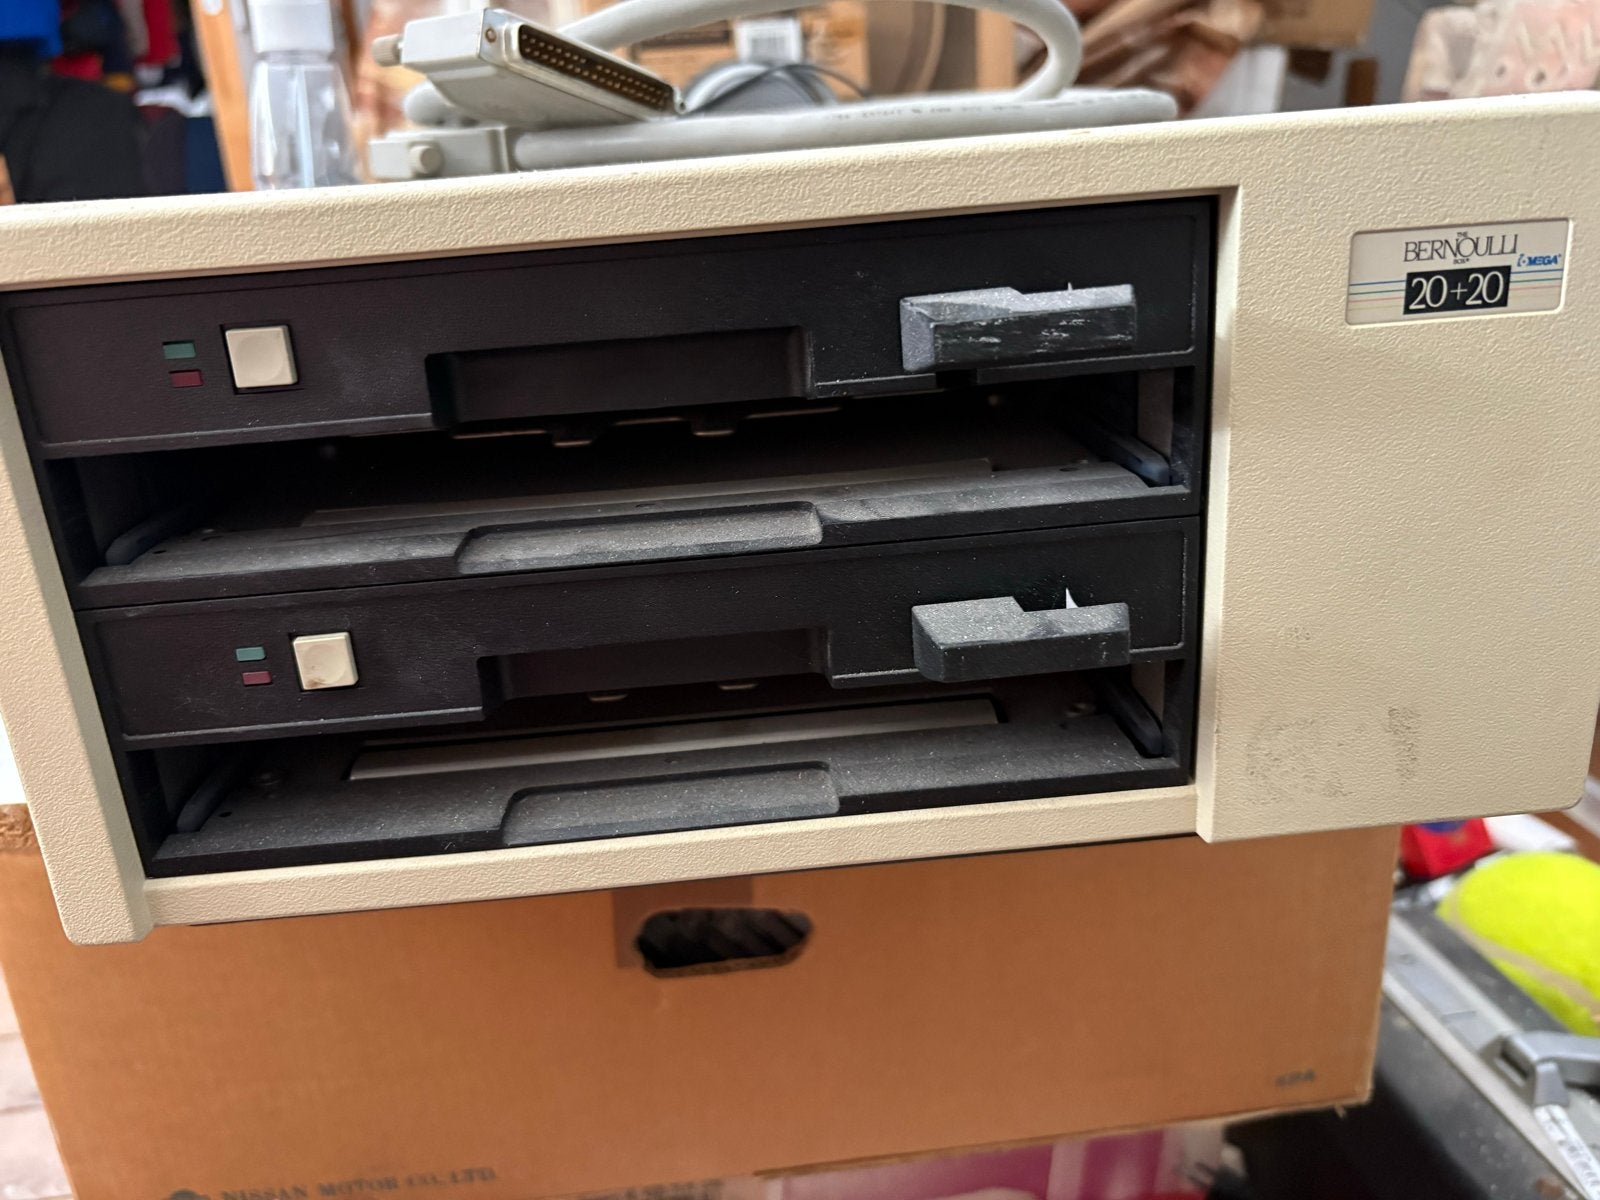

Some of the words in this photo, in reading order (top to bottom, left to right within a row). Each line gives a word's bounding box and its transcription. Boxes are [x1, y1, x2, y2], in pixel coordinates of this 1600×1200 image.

[1404, 234, 1518, 262] BERNOULLI
[1408, 271, 1504, 310] 20+20
[221, 1184, 308, 1200] NISSAN
[317, 1176, 399, 1196] MOTOR
